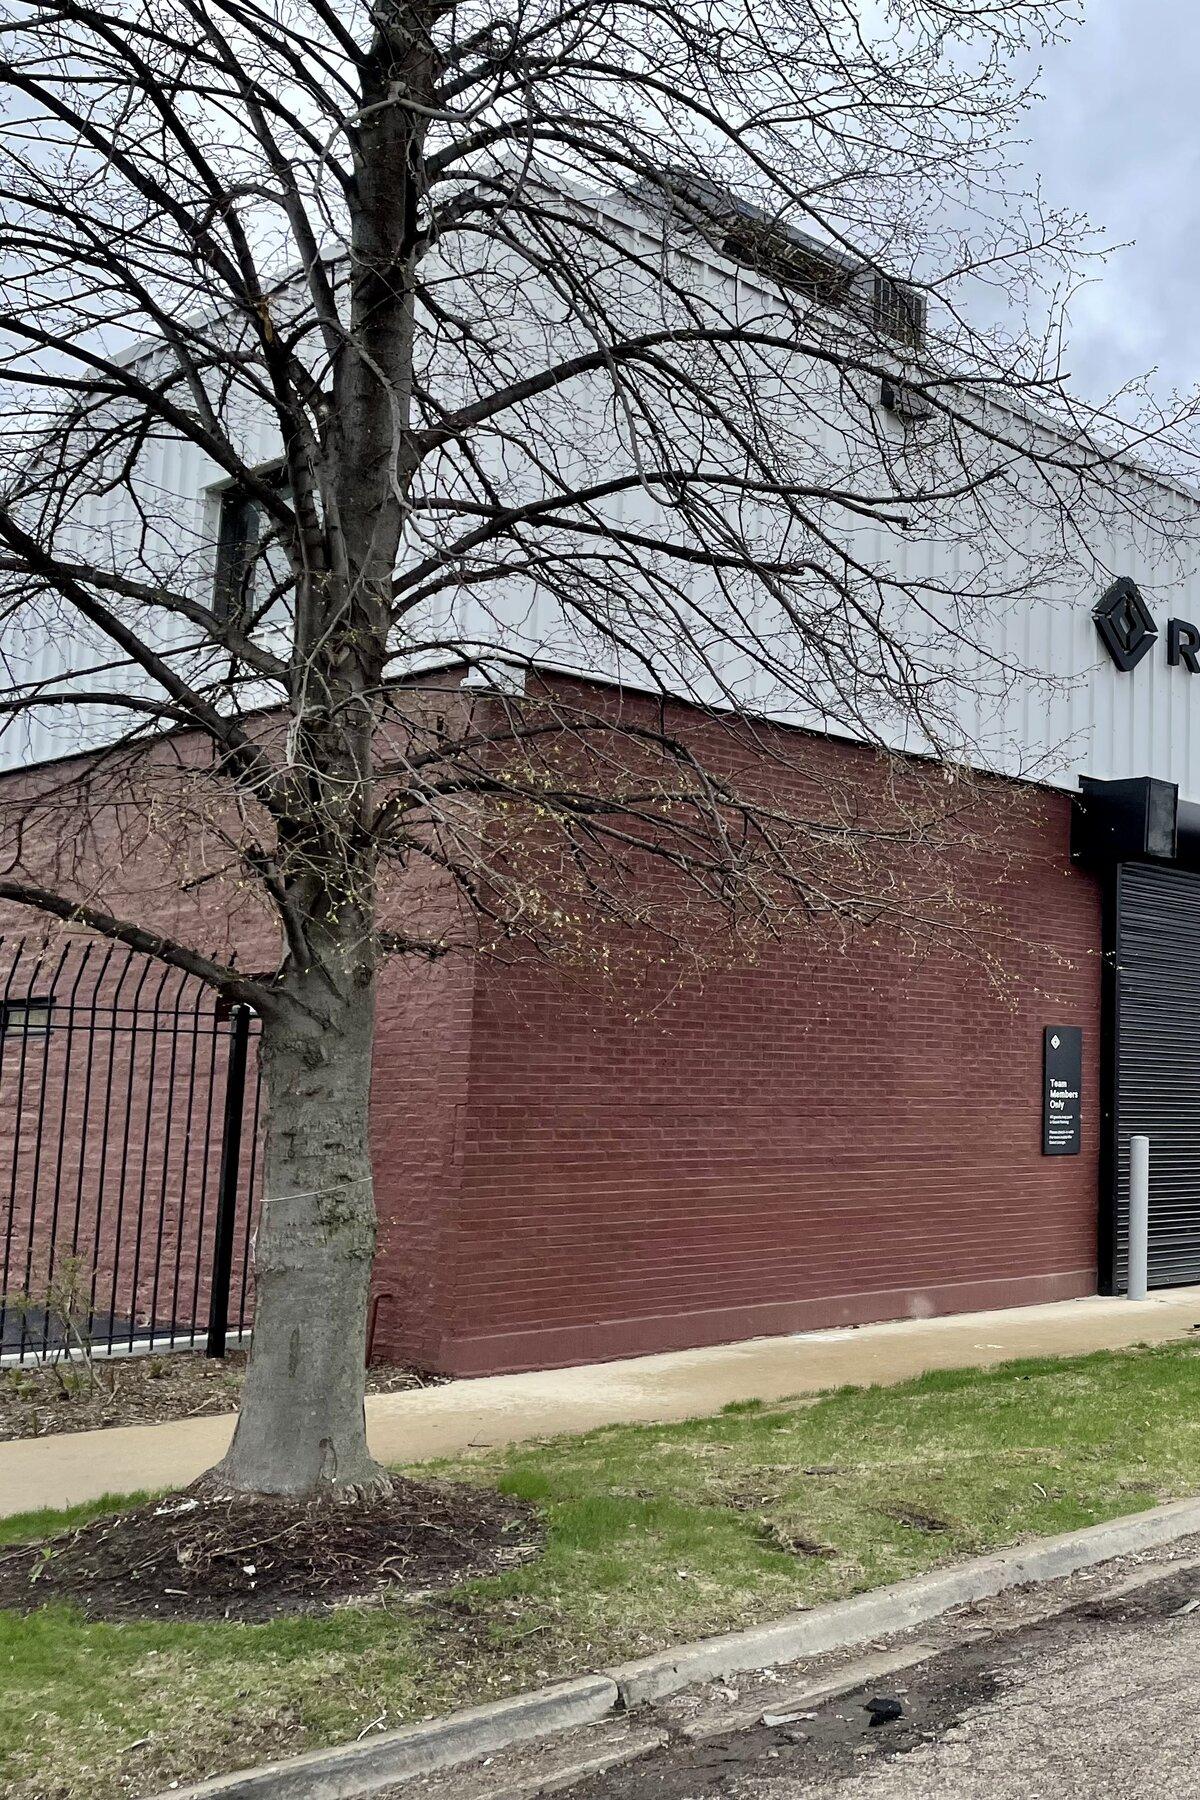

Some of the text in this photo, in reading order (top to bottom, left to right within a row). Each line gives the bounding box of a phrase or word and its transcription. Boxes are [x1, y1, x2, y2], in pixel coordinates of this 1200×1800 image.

[1050, 1079, 1067, 1087] Team
[1050, 1090, 1078, 1098] Members
[1050, 1100, 1064, 1110] Only
